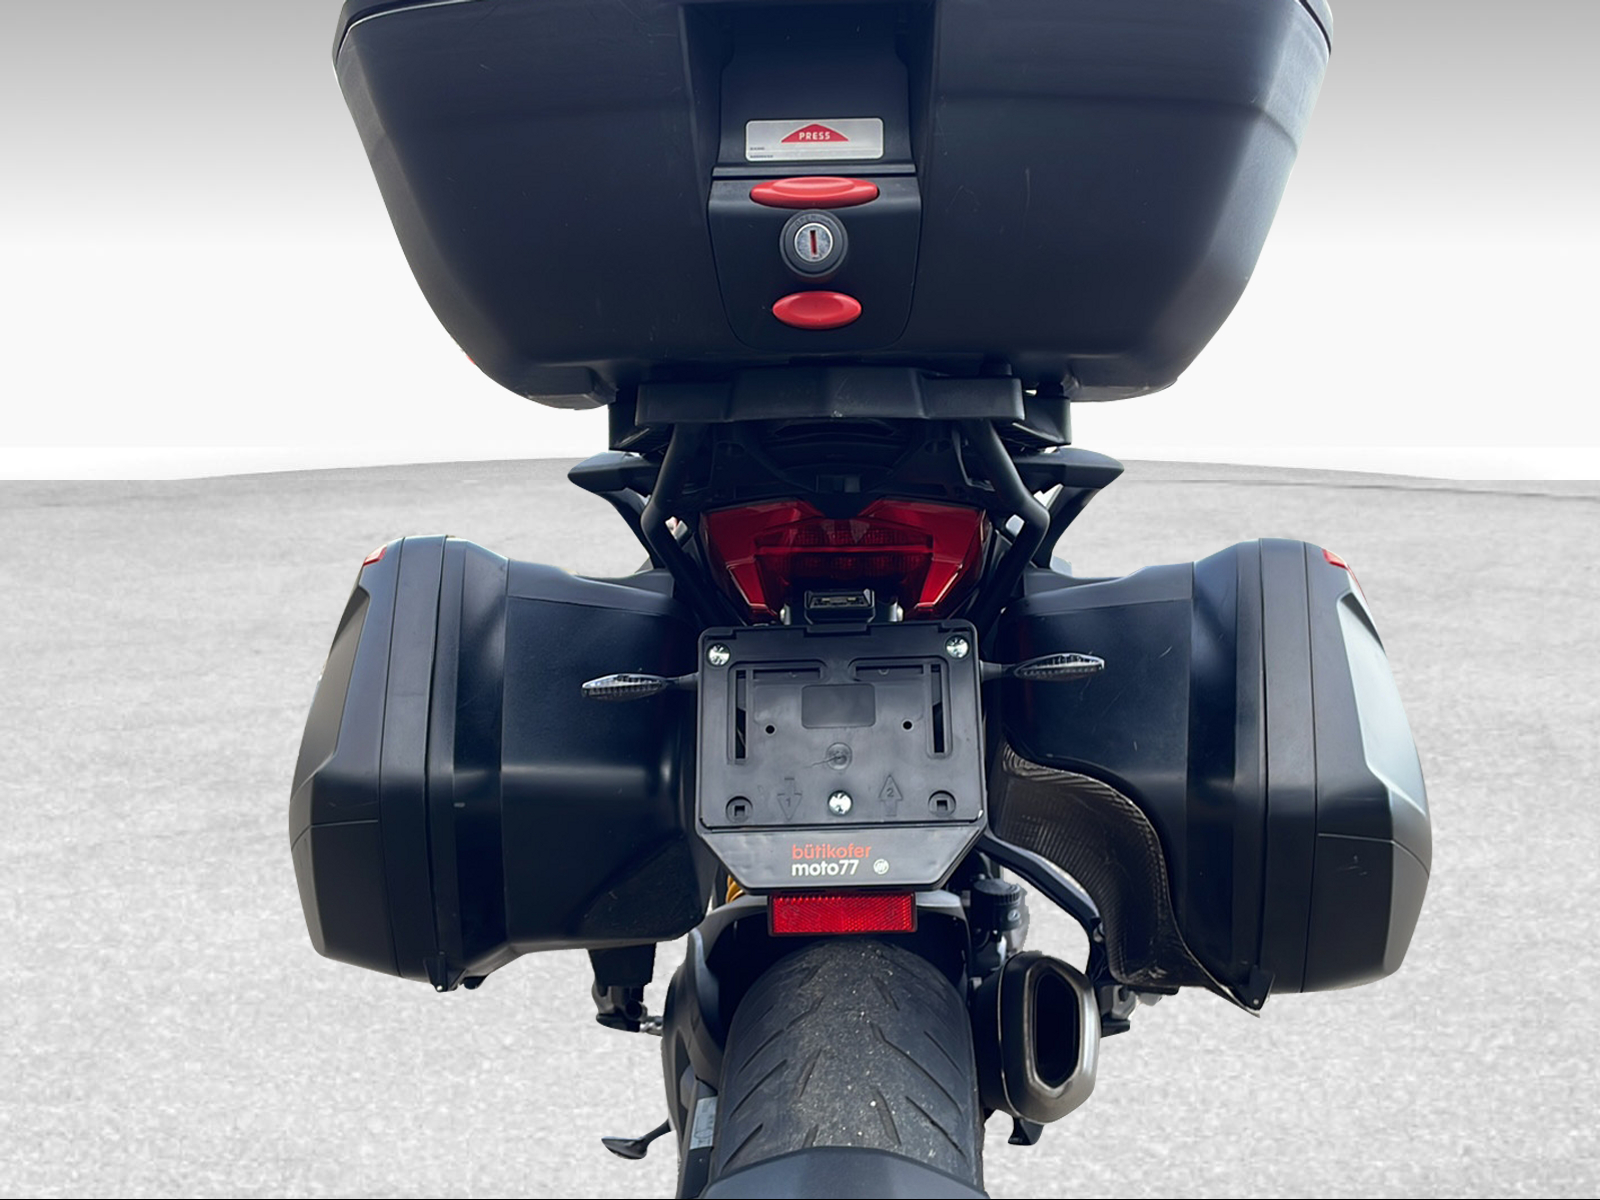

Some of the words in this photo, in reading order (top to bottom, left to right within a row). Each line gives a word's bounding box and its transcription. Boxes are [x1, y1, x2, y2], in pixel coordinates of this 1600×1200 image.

[799, 130, 831, 140] PRESS
[886, 787, 895, 798] 2
[792, 843, 872, 859] bütikofer
[791, 859, 859, 876] moto77
